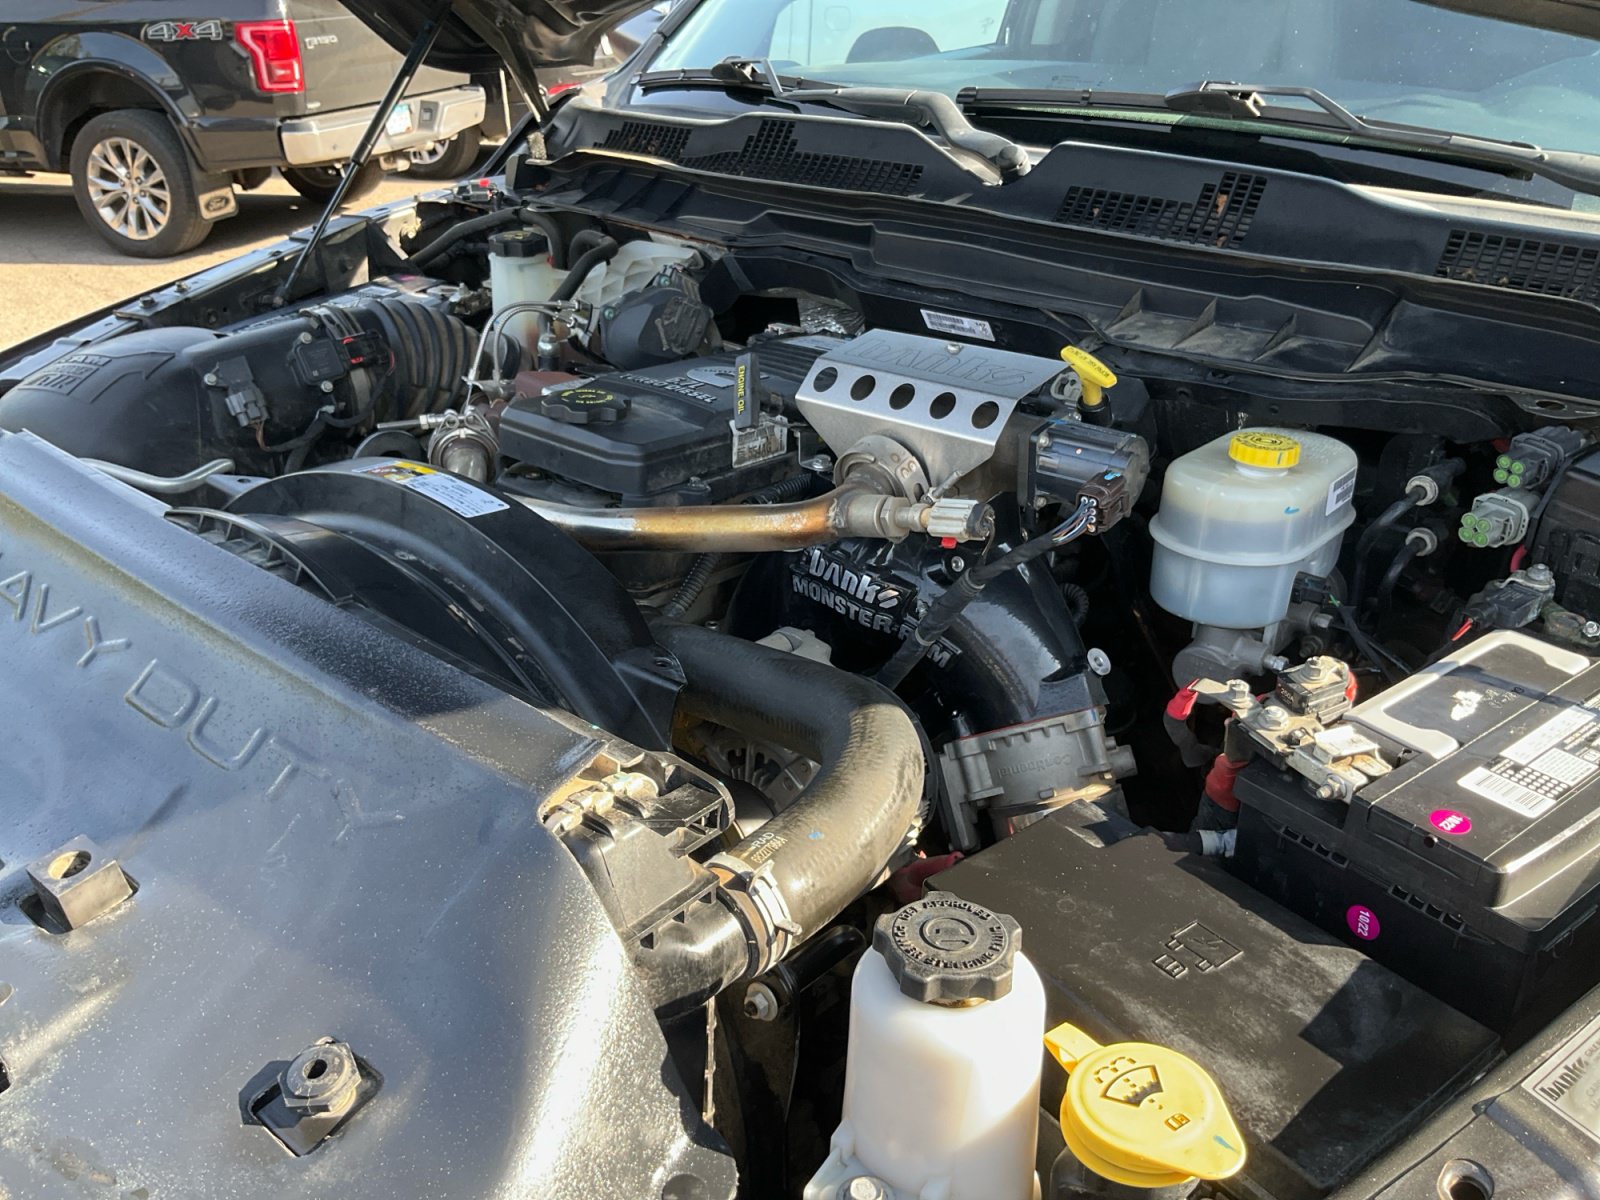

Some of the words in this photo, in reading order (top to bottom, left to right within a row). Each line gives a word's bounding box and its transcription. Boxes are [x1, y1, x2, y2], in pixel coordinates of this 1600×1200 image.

[620, 372, 669, 388] TURBO
[737, 365, 746, 398] ENGINE
[664, 384, 718, 404] DIESEL
[737, 399, 745, 415] OIL
[792, 574, 951, 668] MONSTER-RM
[0, 570, 132, 668] AVY
[124, 657, 406, 844] DUTY
[1357, 910, 1371, 937] 10/22
